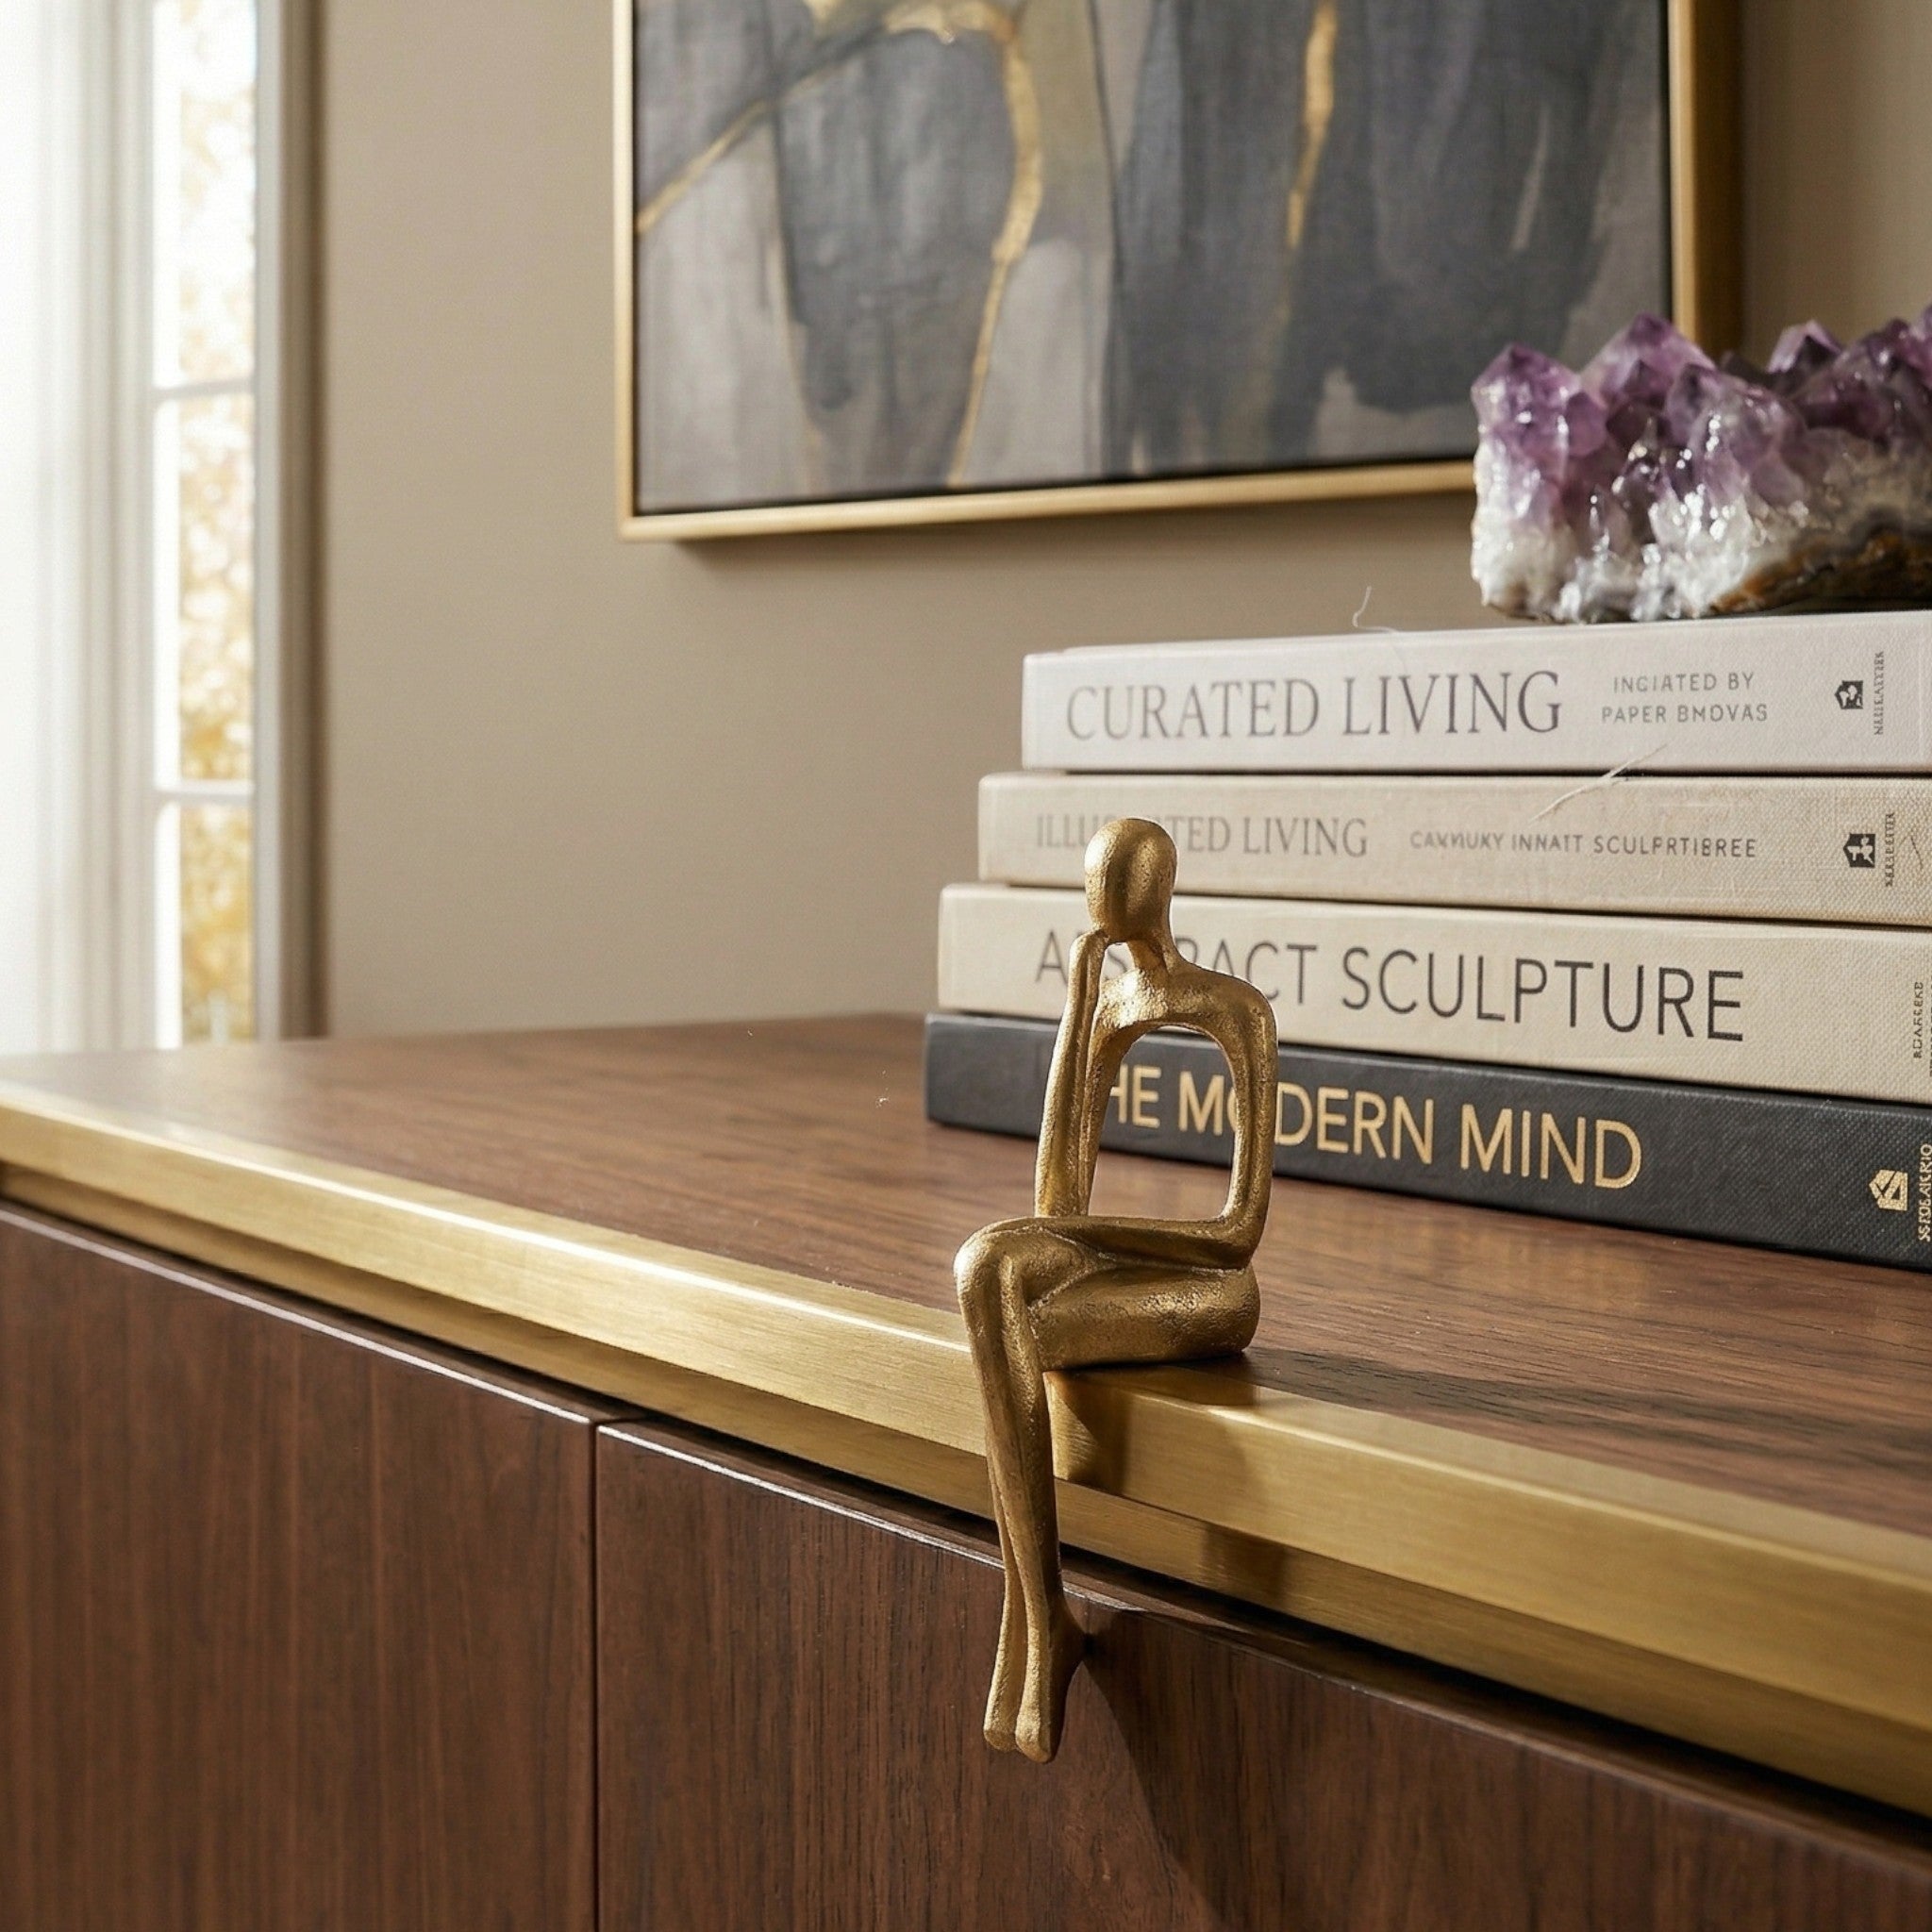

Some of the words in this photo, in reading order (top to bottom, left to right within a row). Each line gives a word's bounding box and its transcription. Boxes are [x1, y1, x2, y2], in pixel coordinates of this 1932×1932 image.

[1066, 677, 1320, 741] CURATED
[1342, 670, 1561, 736] LIVING
[1727, 671, 1754, 691] BY
[1601, 706, 1667, 724] PAPER
[1038, 813, 1231, 853] ILLUTED
[1243, 817, 1368, 858] LIVING
[1341, 946, 1744, 1042] SCULPTURE
[1109, 1063, 1162, 1129] HE
[1179, 1070, 1434, 1165] MDERN
[1460, 1103, 1642, 1190] MIND
